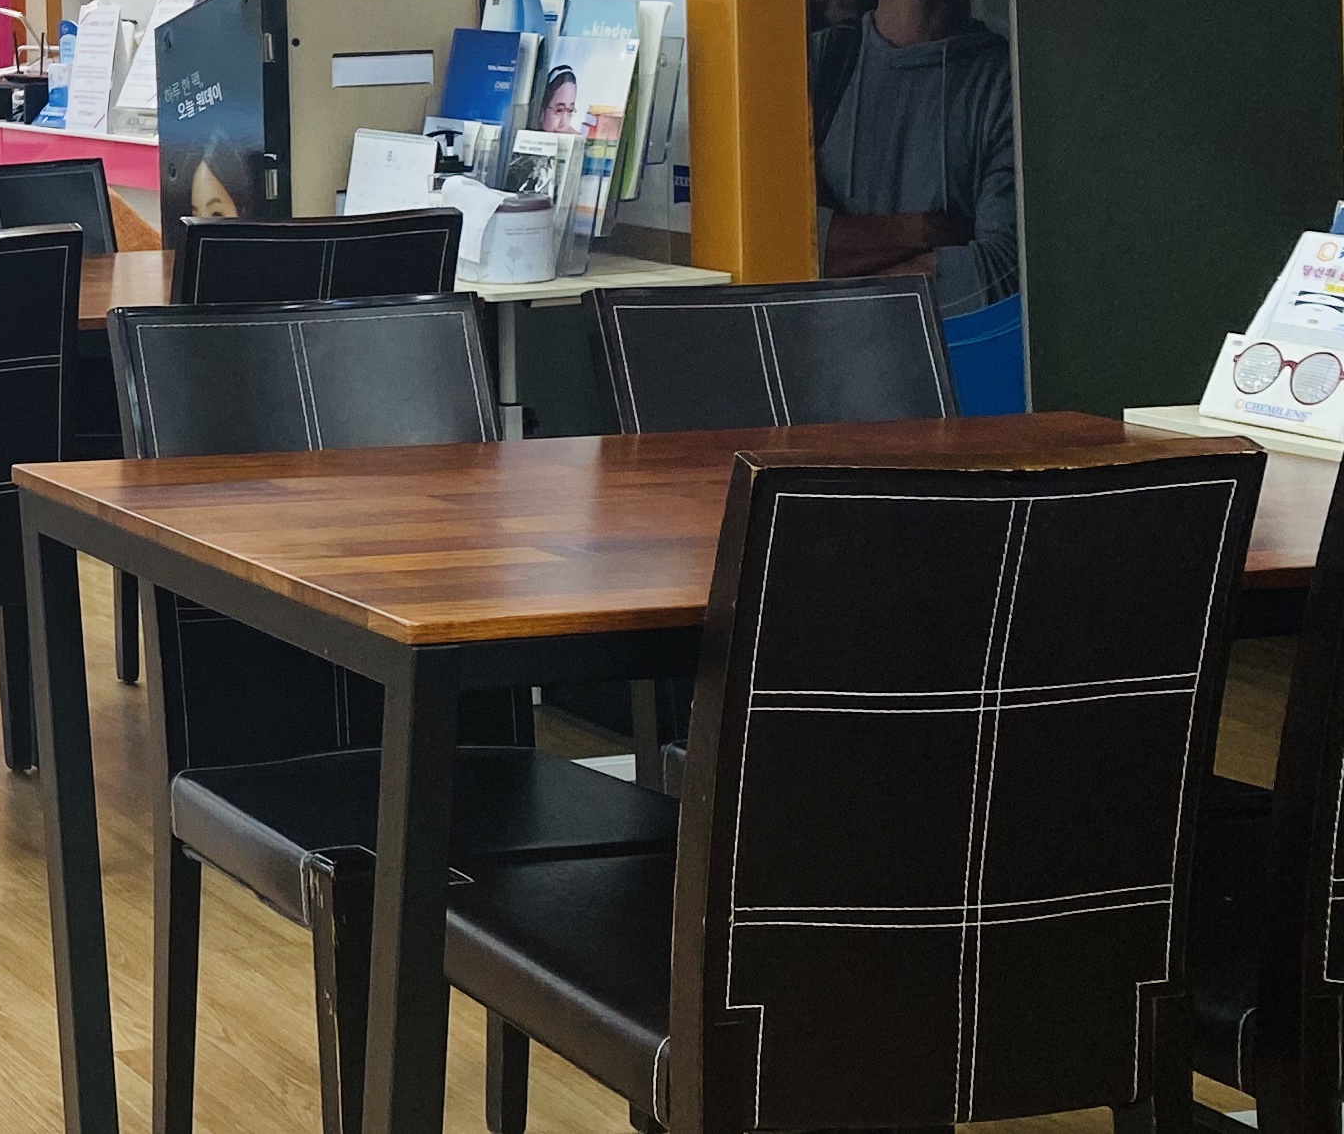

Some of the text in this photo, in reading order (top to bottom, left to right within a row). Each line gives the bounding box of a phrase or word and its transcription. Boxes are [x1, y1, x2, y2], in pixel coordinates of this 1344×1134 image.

[164, 81, 181, 103] 하루
[178, 82, 223, 120] 오늘 원데이
[1245, 400, 1309, 419] CHEMILENS
